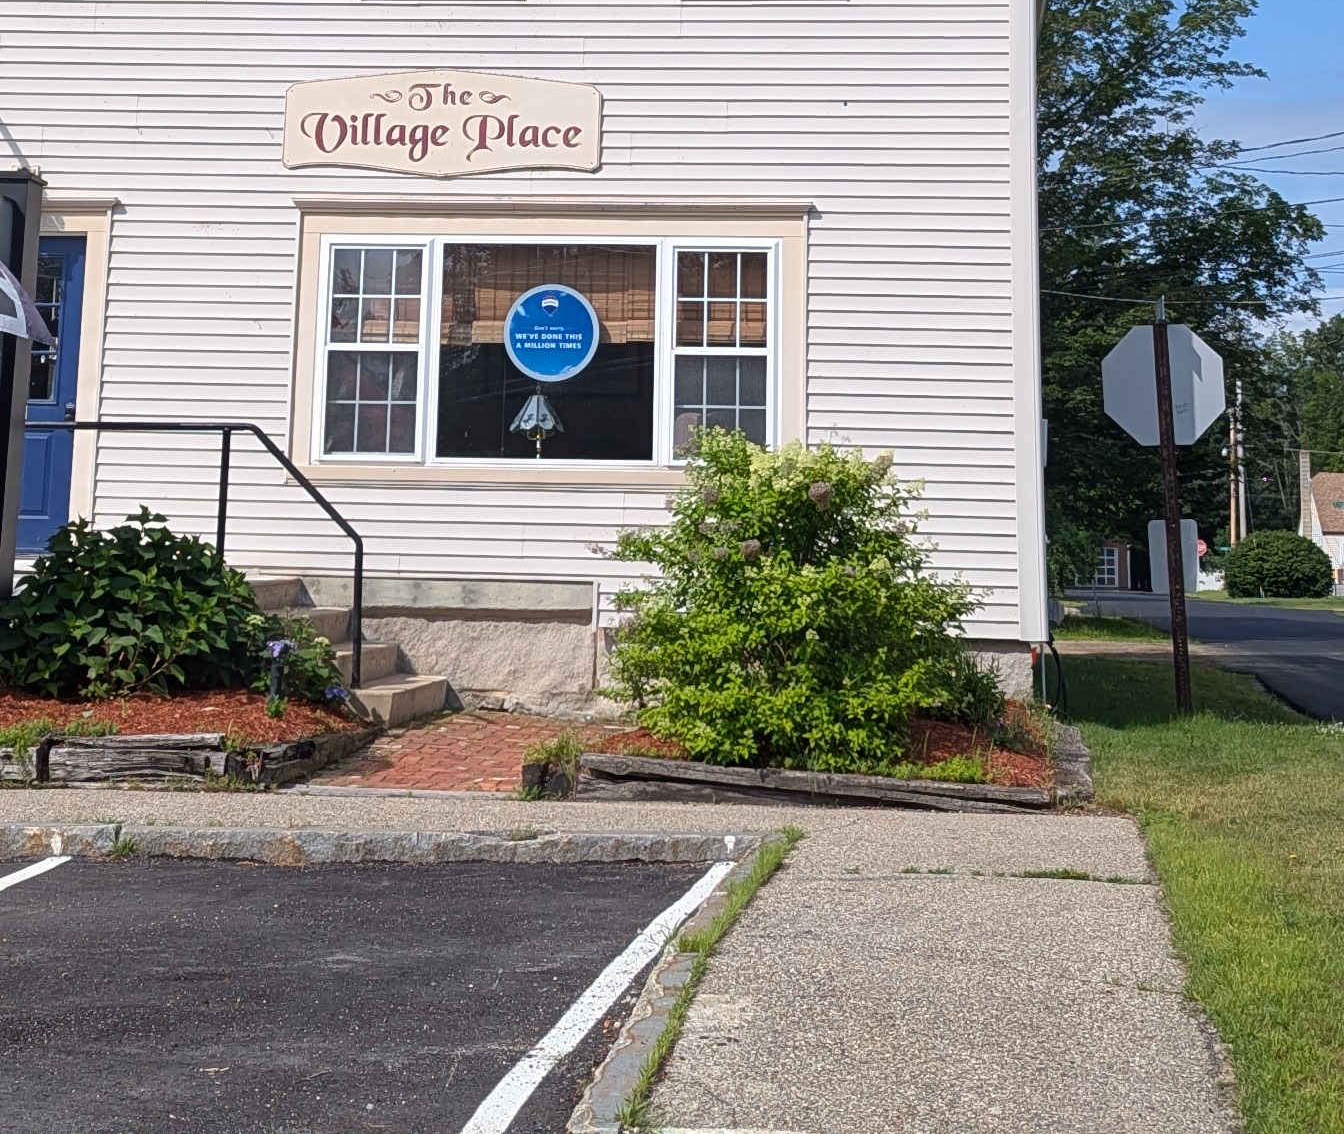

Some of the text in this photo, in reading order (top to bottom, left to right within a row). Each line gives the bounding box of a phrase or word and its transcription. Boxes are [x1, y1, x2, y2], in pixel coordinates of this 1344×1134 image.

[408, 83, 473, 111] The
[300, 112, 583, 163] Village Place
[565, 333, 583, 341] THIS
